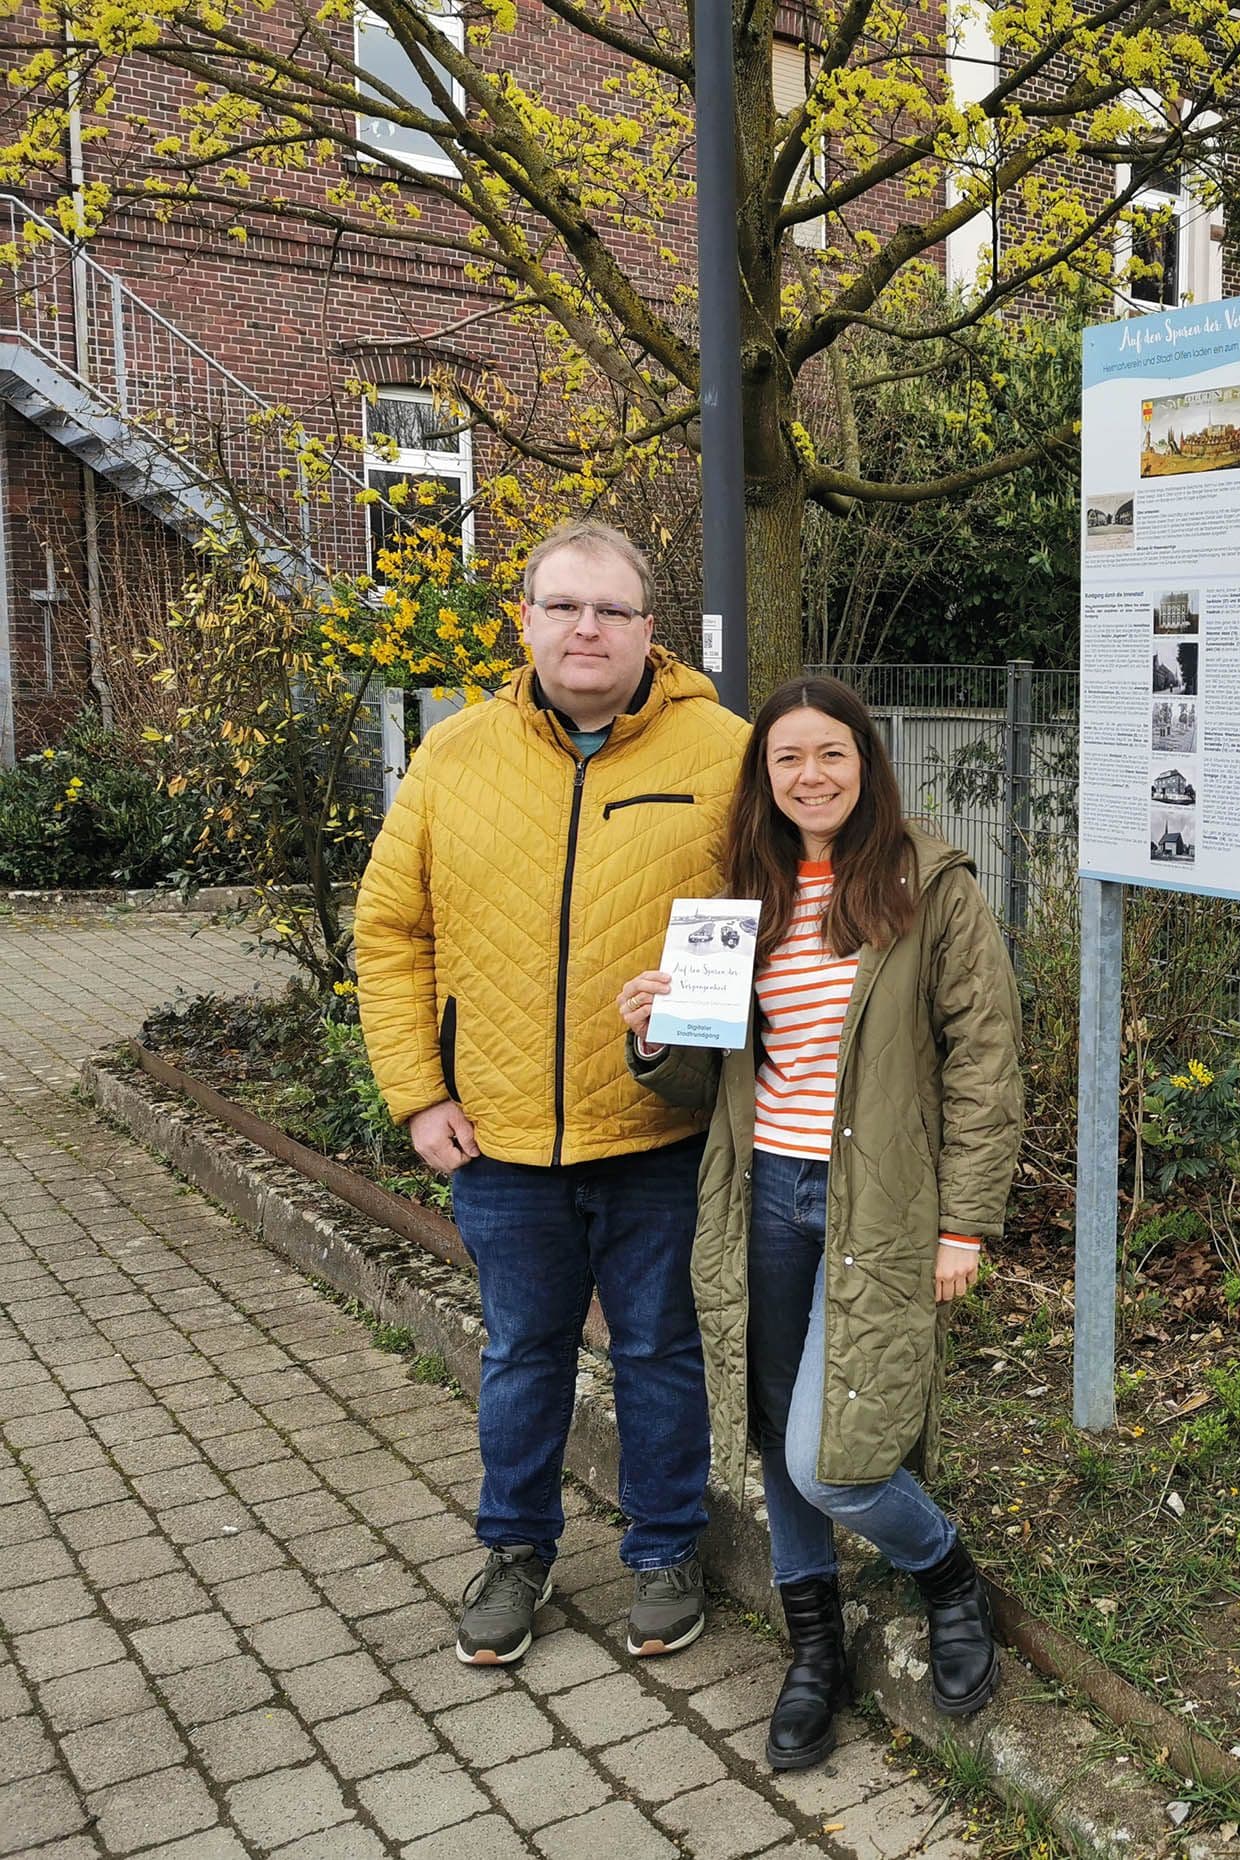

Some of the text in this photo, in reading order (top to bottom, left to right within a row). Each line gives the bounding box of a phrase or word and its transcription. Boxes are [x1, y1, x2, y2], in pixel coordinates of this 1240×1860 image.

[1119, 327, 1142, 353] Auf
[1143, 328, 1162, 345] den
[1165, 318, 1201, 347] Spuren
[1203, 317, 1220, 334] der
[1102, 359, 1142, 373] Heimatverein
[1142, 356, 1155, 367] und
[1156, 352, 1173, 365] Stadt
[1174, 348, 1191, 362] Olfen
[1192, 346, 1212, 359] laden
[1213, 344, 1223, 355] ein
[1223, 343, 1239, 353] zum
